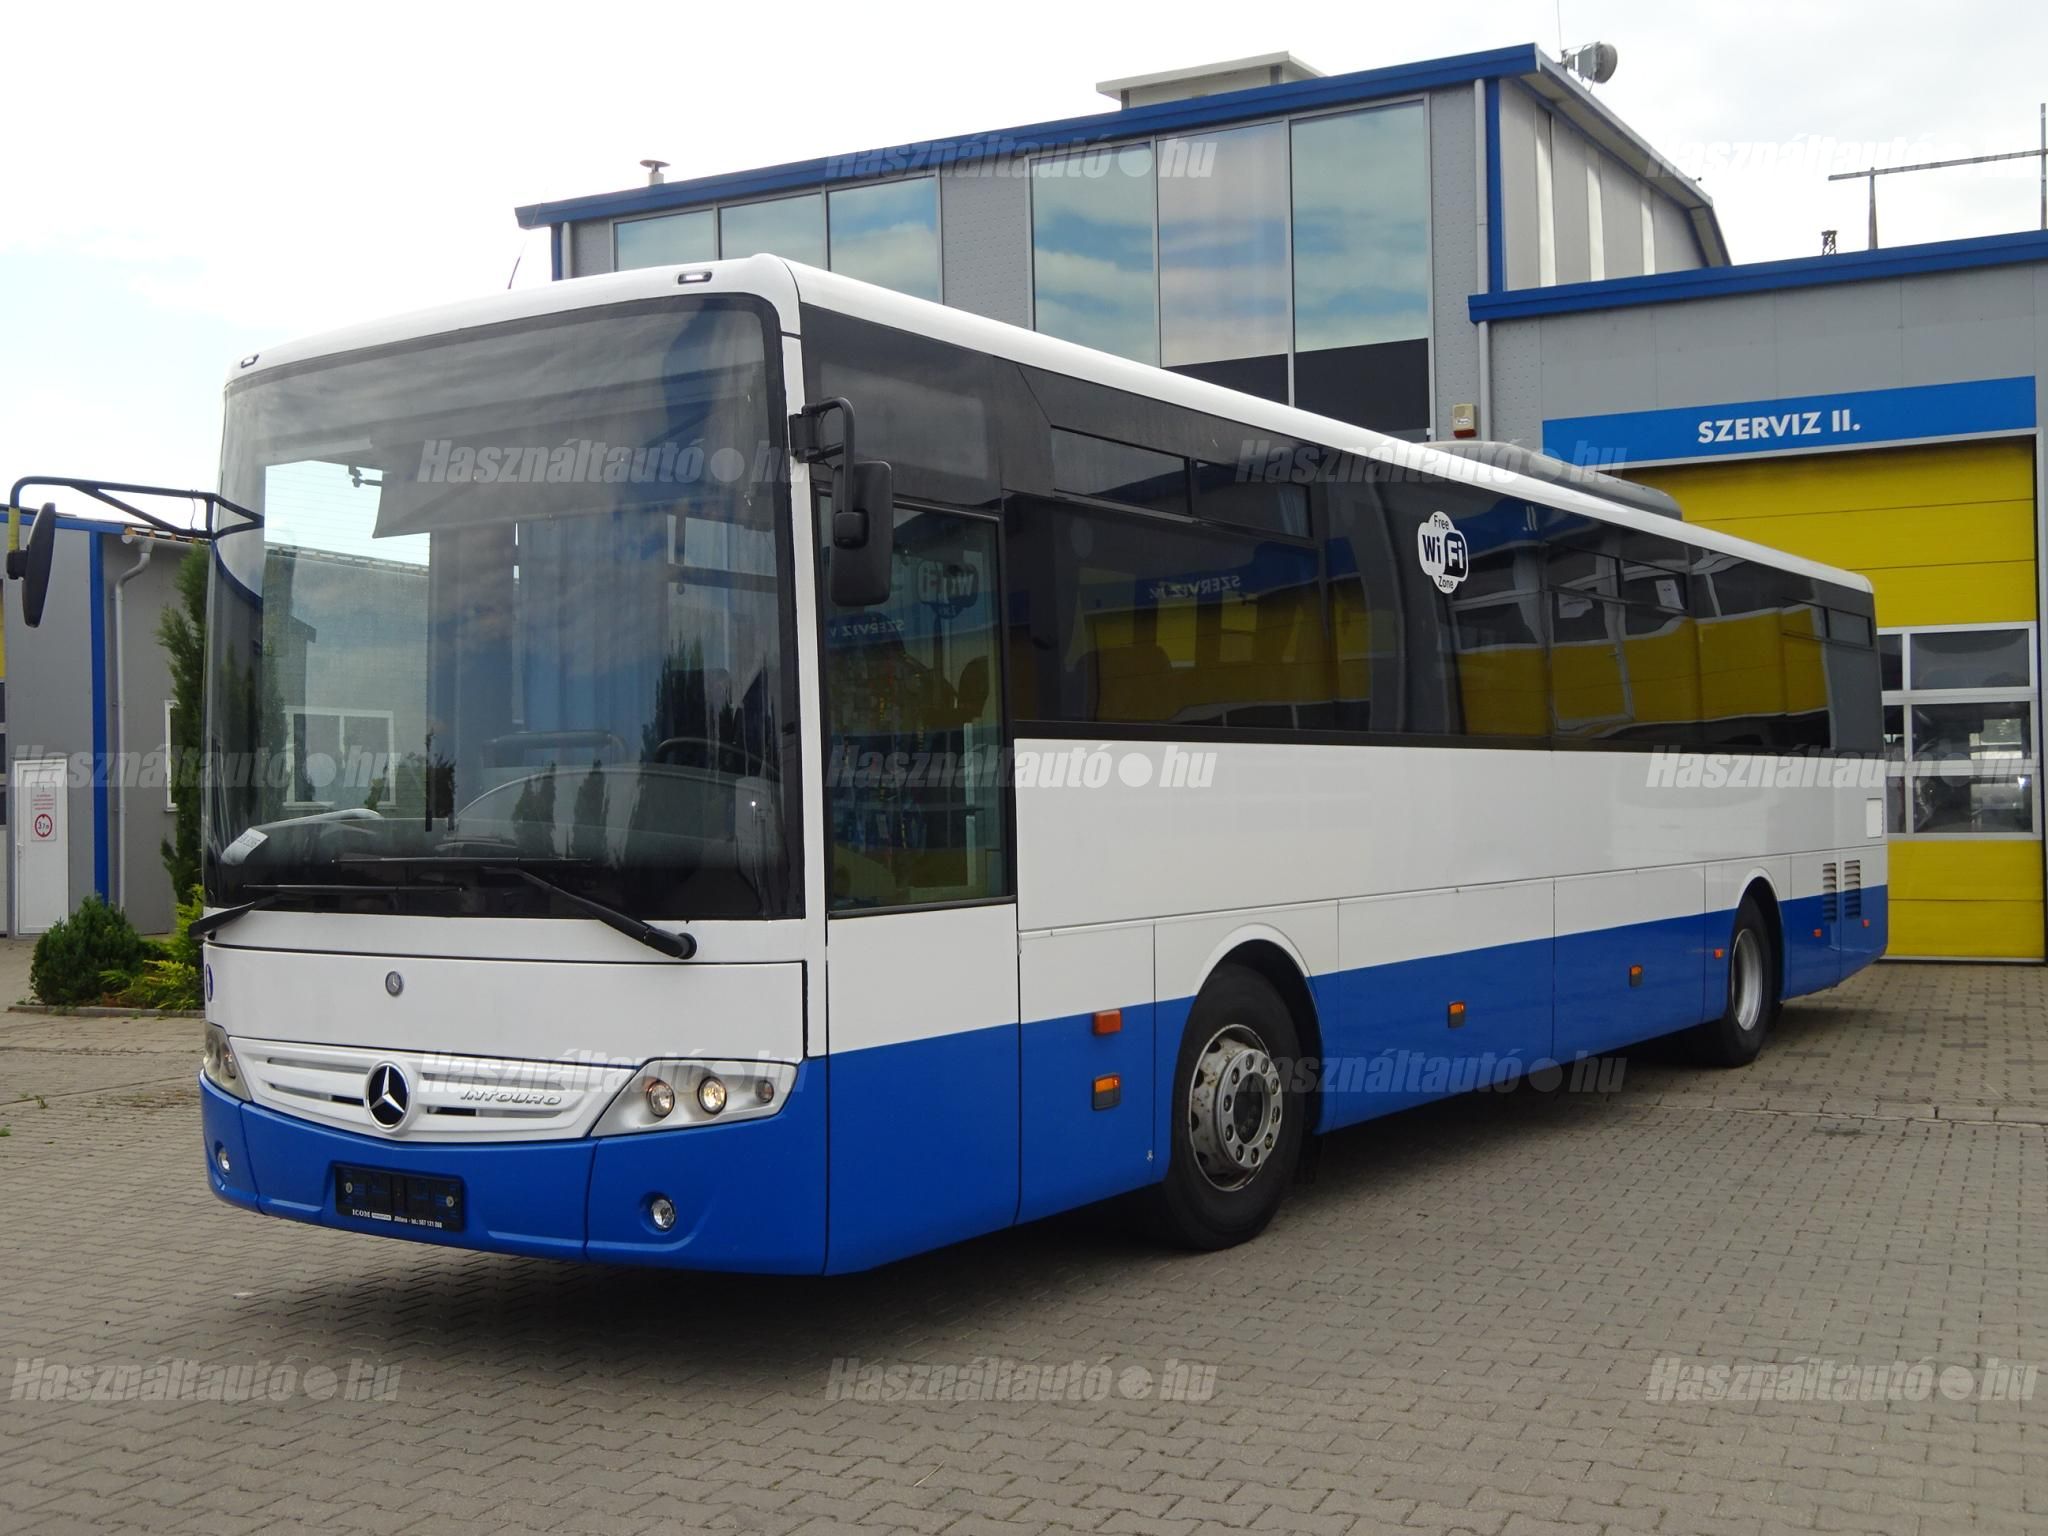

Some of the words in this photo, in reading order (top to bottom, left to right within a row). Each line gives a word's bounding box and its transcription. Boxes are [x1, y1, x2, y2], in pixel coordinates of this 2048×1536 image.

[1697, 411, 1822, 443] SZERVIZ
[1832, 409, 1861, 432] II.
[1433, 515, 1450, 530] Free
[1438, 576, 1454, 589] Zone
[461, 1090, 561, 1105] INTOURO
[352, 1209, 370, 1218] ICOM
